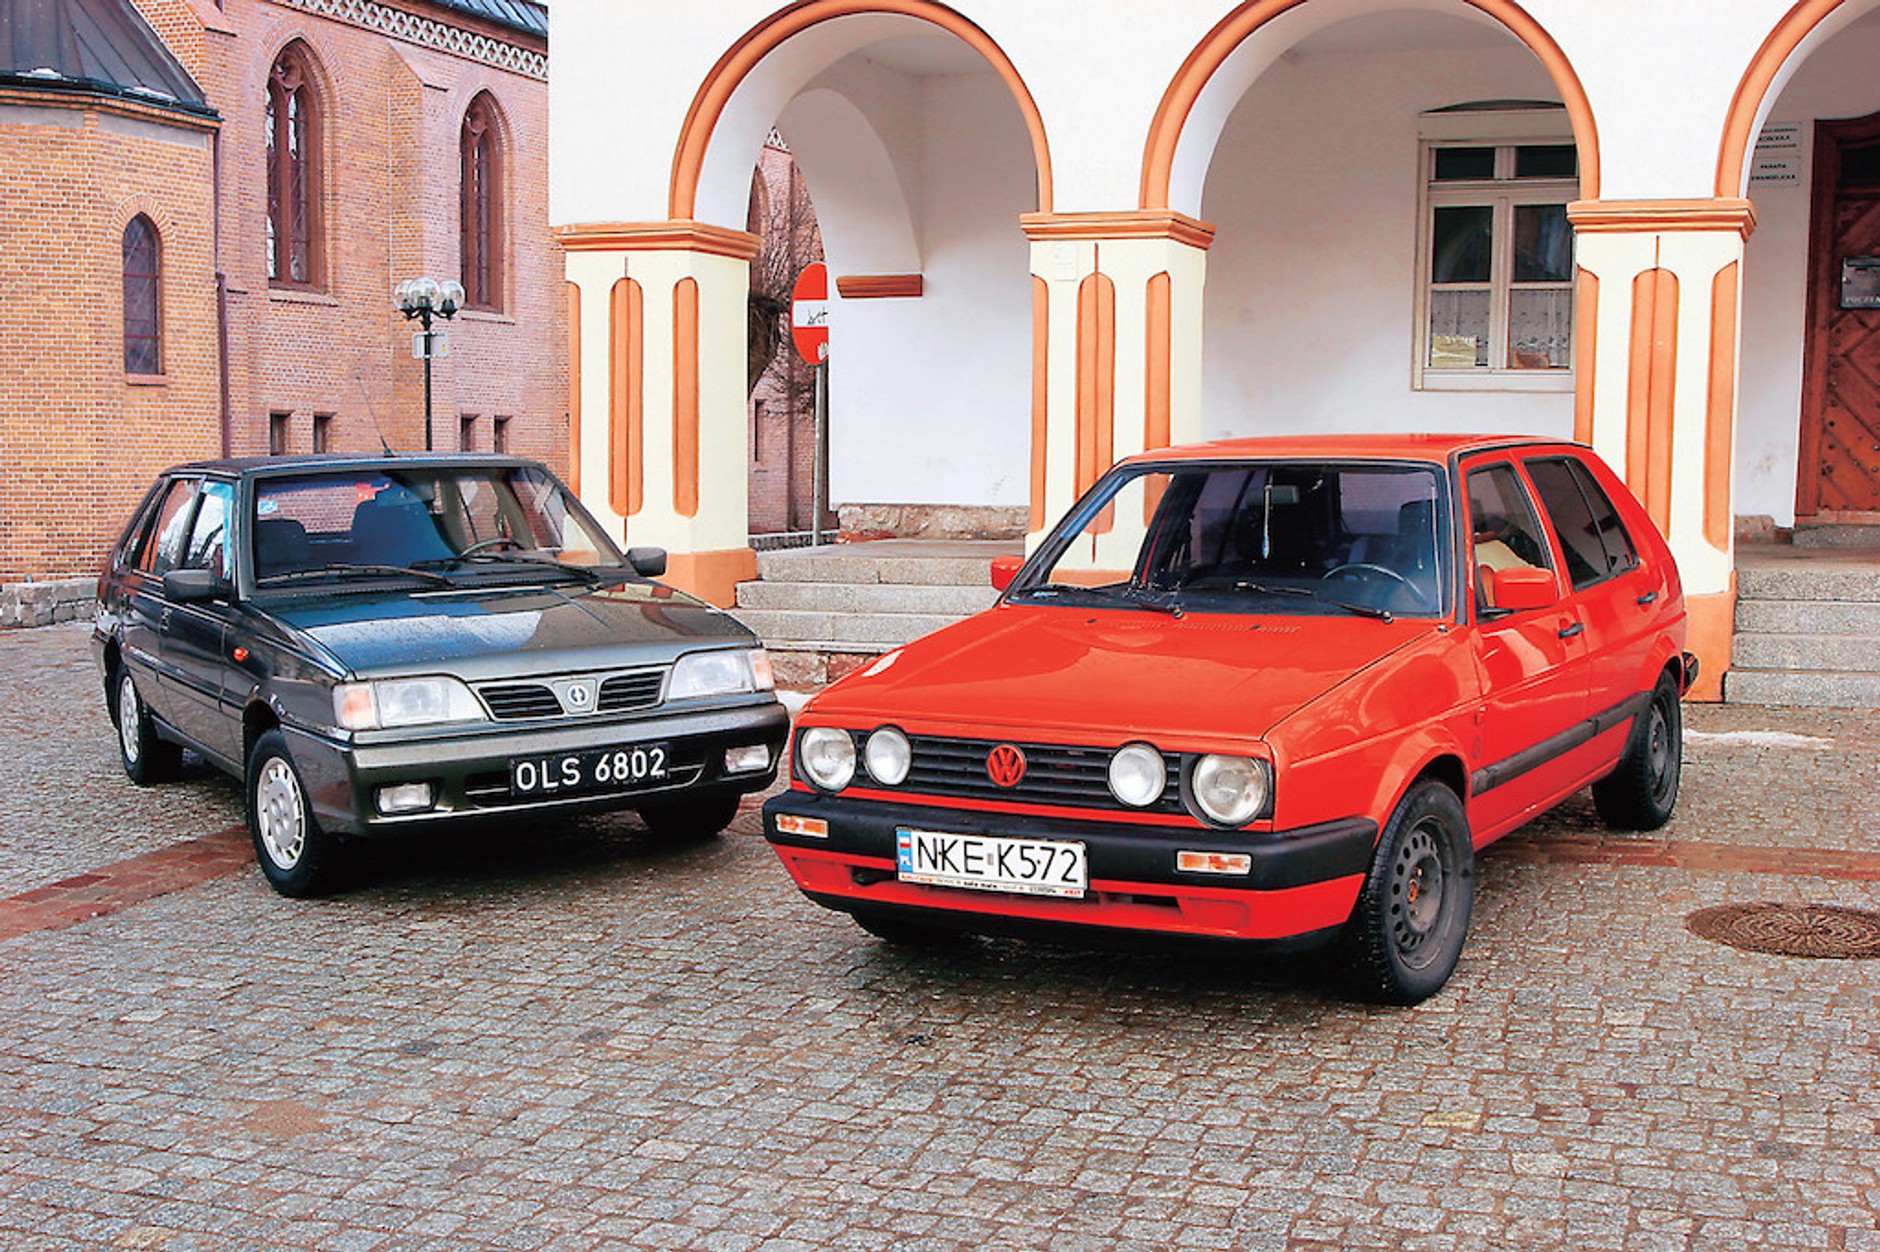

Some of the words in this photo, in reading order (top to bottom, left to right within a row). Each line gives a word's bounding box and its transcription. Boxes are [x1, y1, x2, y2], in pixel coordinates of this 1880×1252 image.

[516, 757, 581, 791] OLS
[594, 748, 666, 782] 6802
[986, 744, 1025, 787] VW
[917, 836, 984, 875] NKE
[997, 843, 1078, 883] K572
